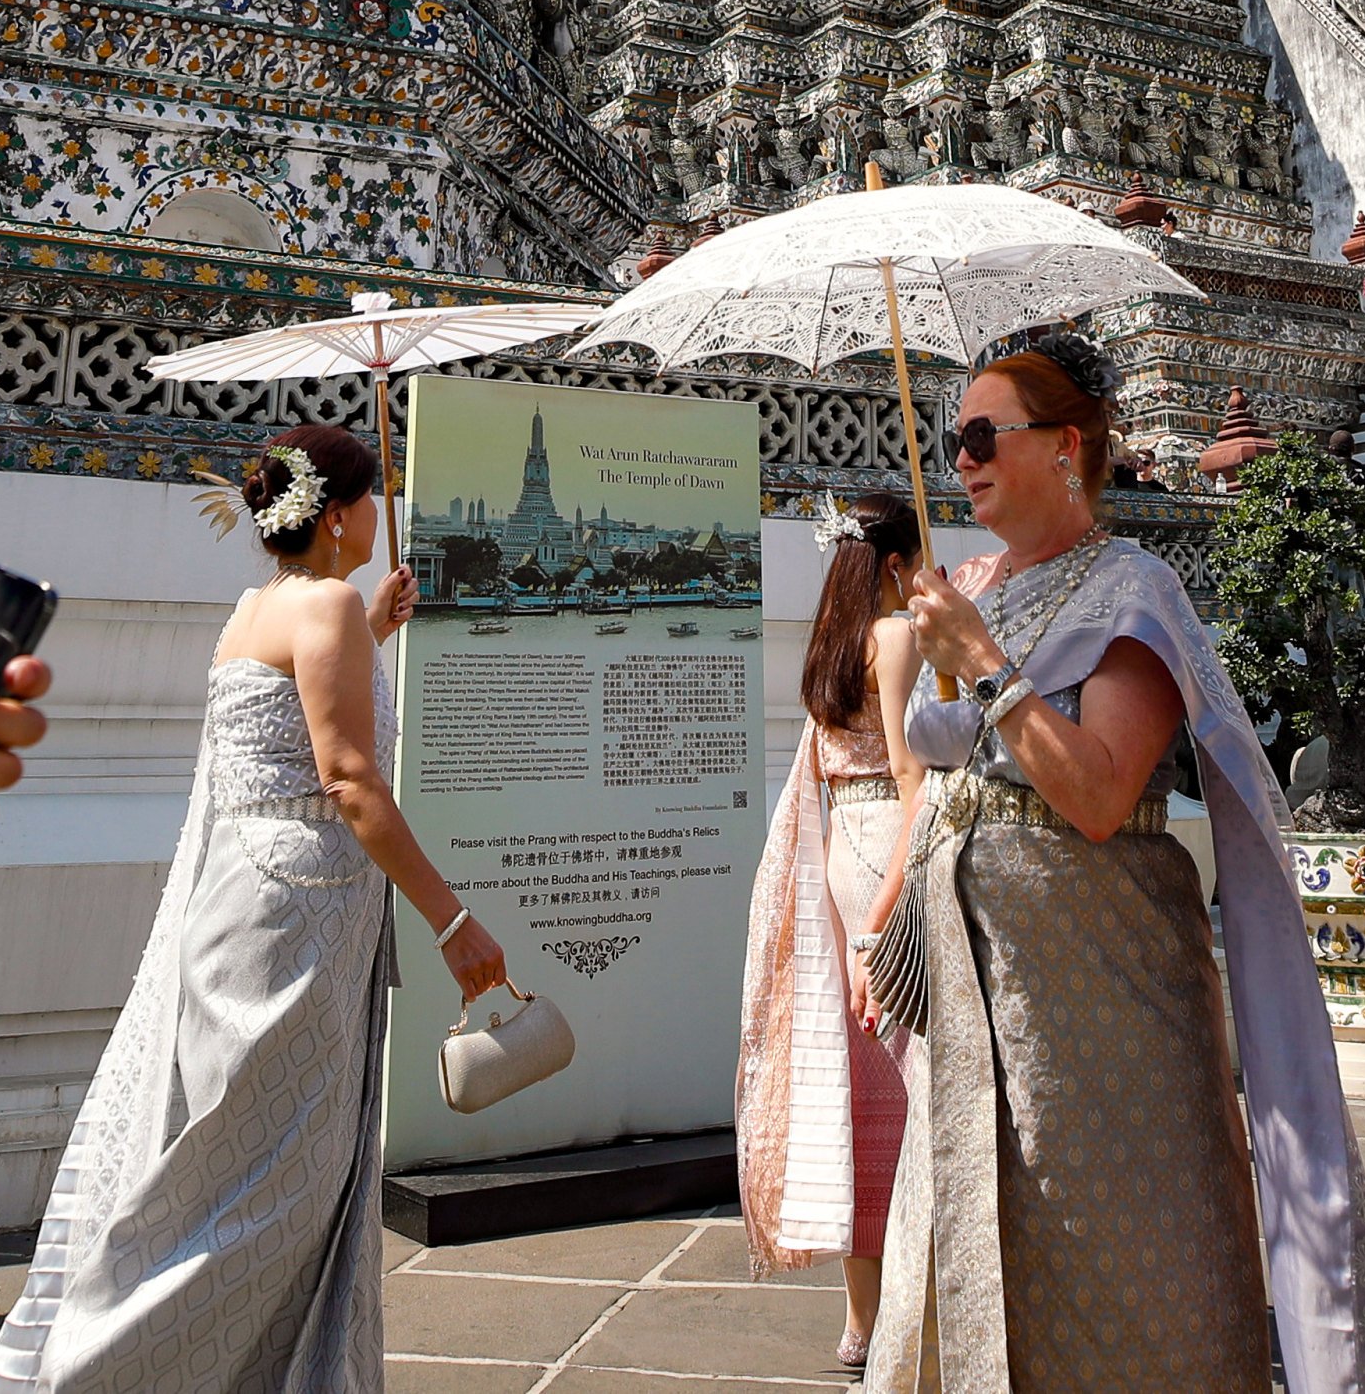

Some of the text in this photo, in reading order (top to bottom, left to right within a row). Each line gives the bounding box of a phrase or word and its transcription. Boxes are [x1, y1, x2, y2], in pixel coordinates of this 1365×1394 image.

[580, 445, 738, 468] Wat Arun Ratchawararam
[598, 469, 724, 489] The Temple of Dawn
[451, 827, 720, 849] Please visit the Prang with respect to the Buddha's Relics
[501, 845, 682, 867] 佛陀遗骨位于佛塔中，请尊重地参观
[473, 880, 499, 889] more
[502, 877, 530, 888] about
[533, 876, 548, 886] the
[552, 874, 589, 885] Buddha
[592, 872, 610, 882] and
[612, 871, 627, 881] His
[630, 868, 678, 880] Teachings,
[681, 867, 710, 879] please
[713, 864, 731, 875] visit
[530, 912, 652, 928] www.knowingbuddha.org
